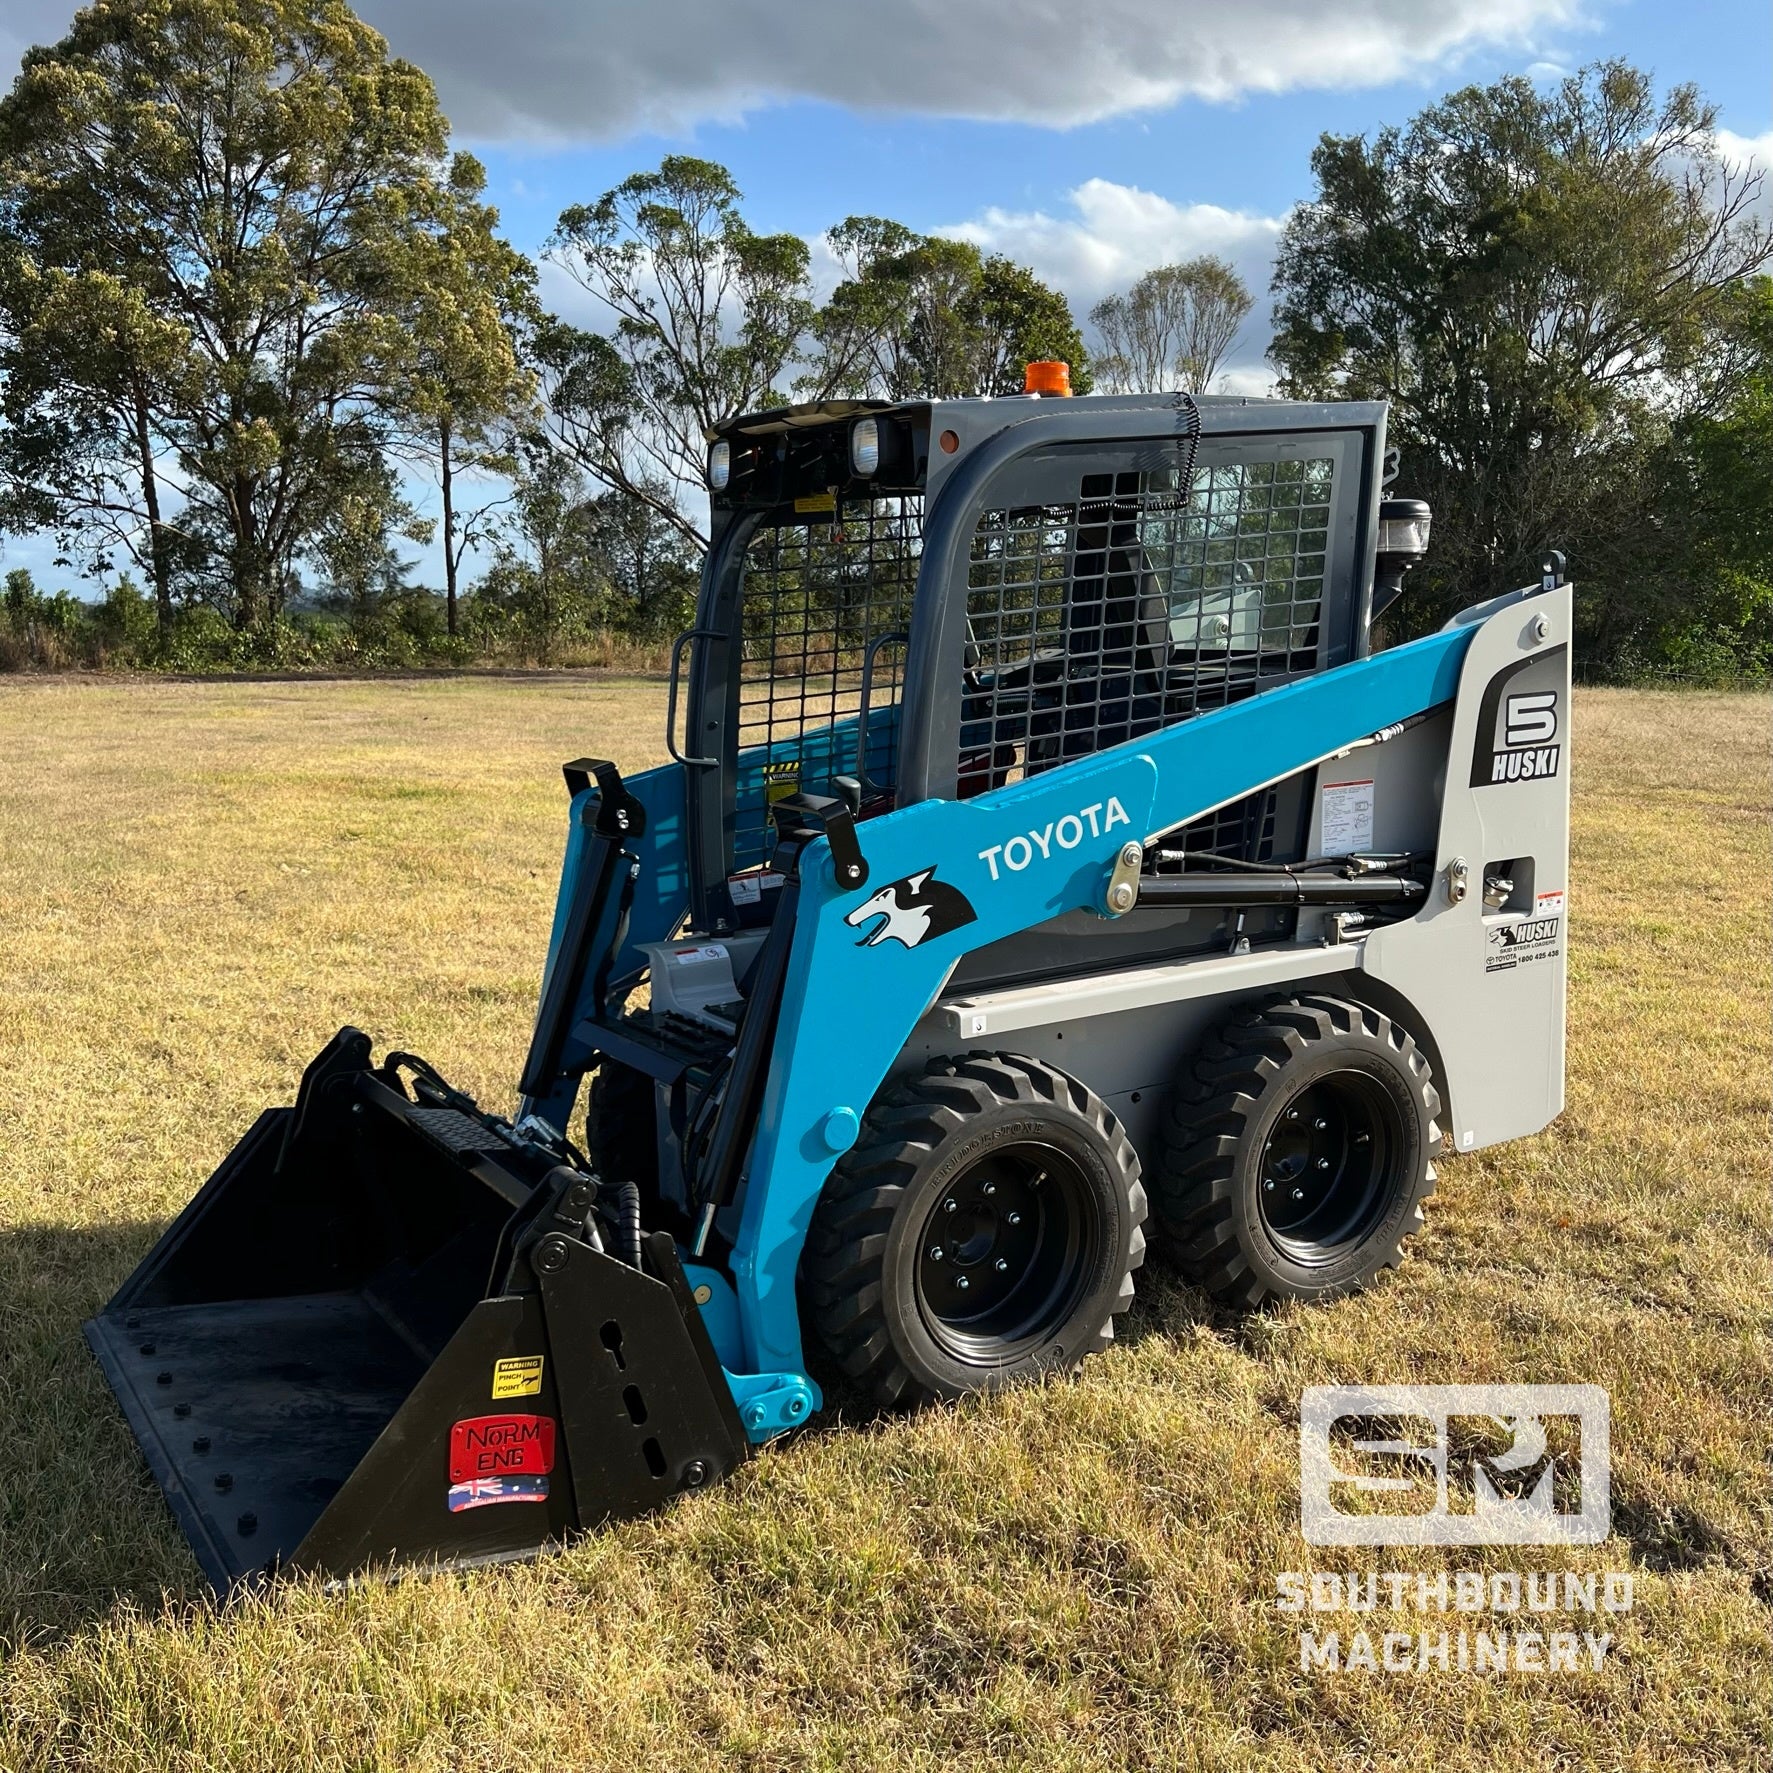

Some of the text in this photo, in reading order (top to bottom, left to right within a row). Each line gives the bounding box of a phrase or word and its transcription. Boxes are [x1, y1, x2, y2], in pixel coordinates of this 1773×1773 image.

[1506, 692, 1557, 746] 5
[1492, 748, 1557, 781] HUSKI
[978, 796, 1131, 881] TOYOTA
[1516, 919, 1558, 943] HUSKI
[1532, 940, 1556, 948] LOADERS
[1495, 954, 1517, 962] TOYOTA
[1518, 955, 1533, 963] 1800
[501, 1361, 539, 1370] WARNING
[498, 1384, 520, 1392] POINT
[478, 1448, 524, 1470] ENG
